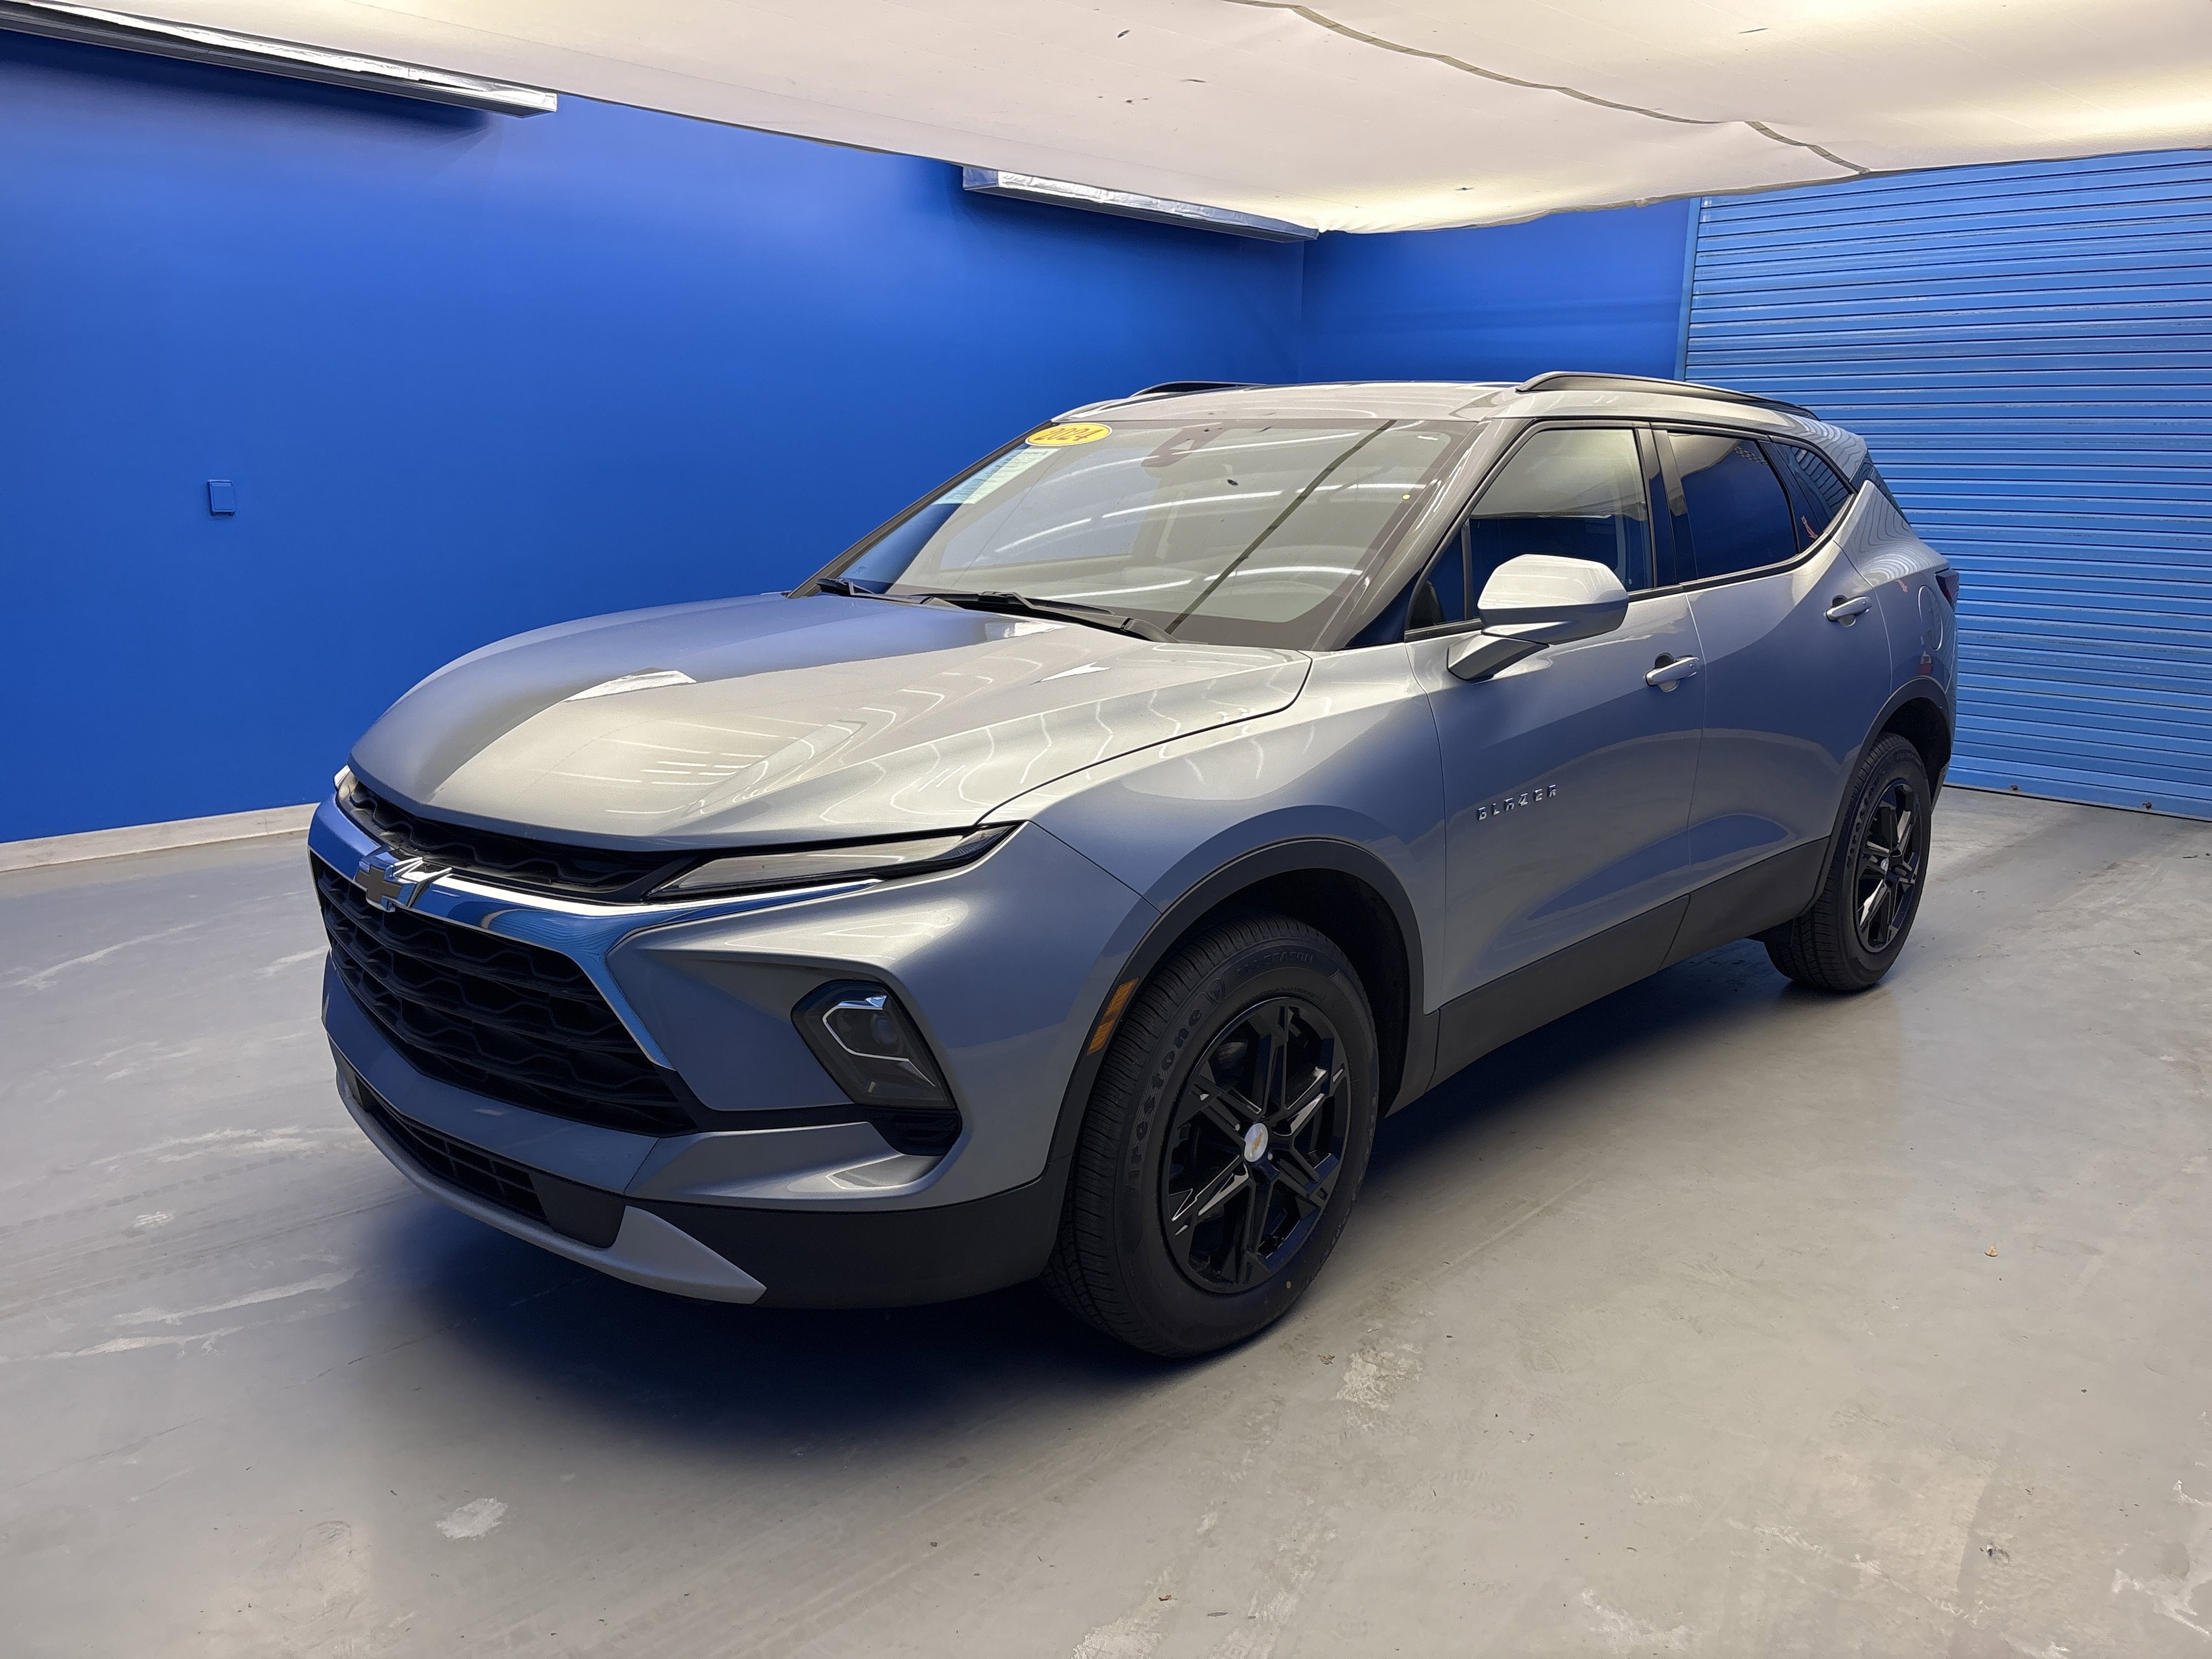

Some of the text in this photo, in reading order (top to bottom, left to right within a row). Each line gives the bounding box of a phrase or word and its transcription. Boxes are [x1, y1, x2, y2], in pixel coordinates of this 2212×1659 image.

[1033, 428, 1104, 441] 2024
[1476, 783, 1558, 821] BLAZER
[1124, 1008, 1203, 1196] irestone
